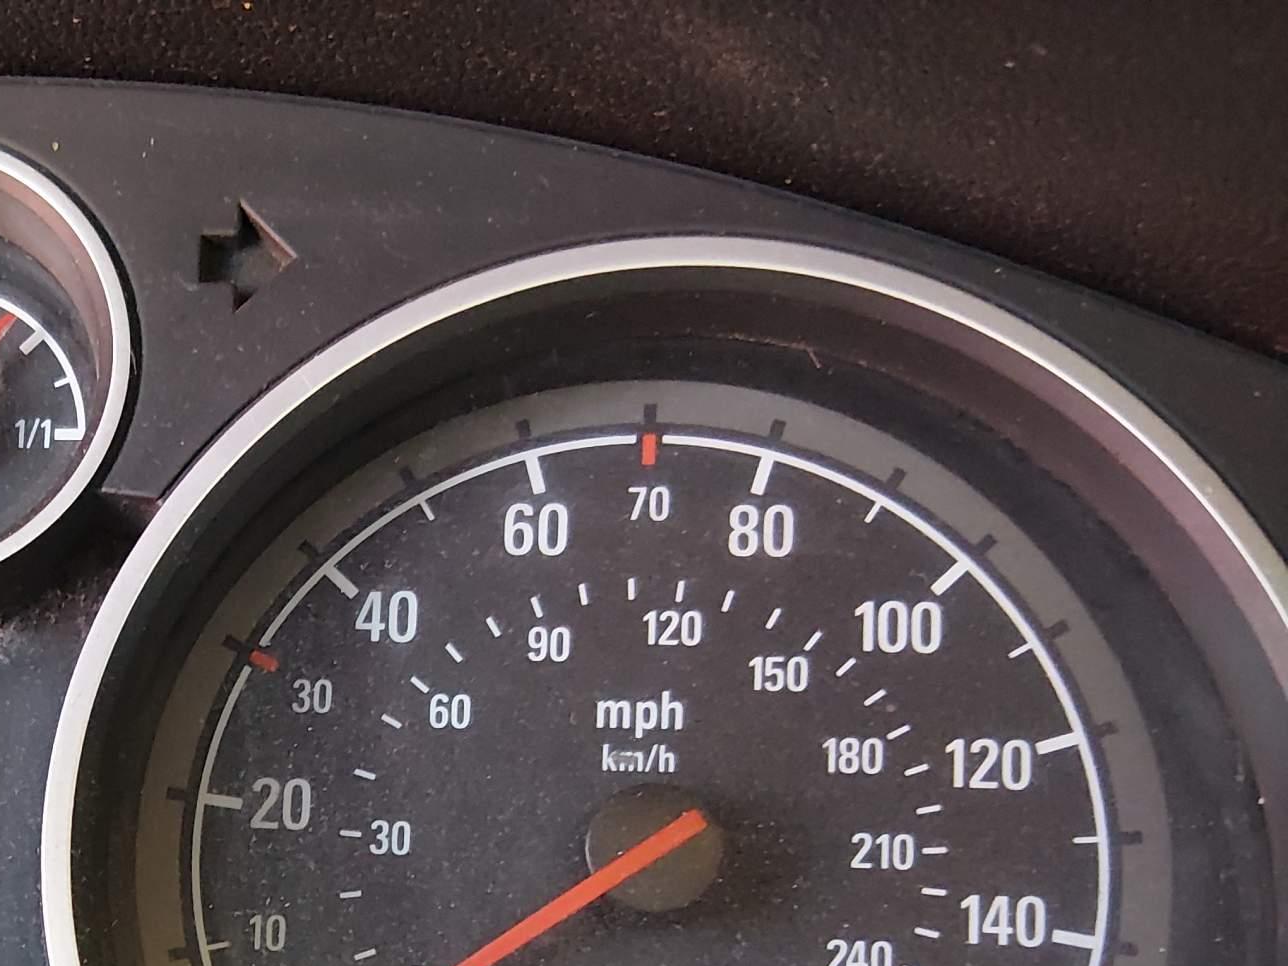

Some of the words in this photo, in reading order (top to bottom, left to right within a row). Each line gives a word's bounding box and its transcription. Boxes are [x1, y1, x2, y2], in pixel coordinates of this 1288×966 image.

[15, 418, 52, 449] 1/1
[627, 486, 670, 522] 70
[503, 503, 569, 556] 60
[728, 504, 794, 558] 80
[355, 590, 418, 643] 40
[643, 610, 702, 646] 120
[853, 600, 942, 654] 100
[528, 626, 570, 662] 90
[748, 656, 809, 692] 150
[291, 678, 333, 714] 30
[429, 693, 471, 730] 60
[596, 691, 684, 738] mph
[821, 737, 884, 775] 180
[944, 739, 1032, 791] 120
[250, 777, 312, 831] 20
[369, 820, 411, 855] 30
[850, 833, 914, 870] 210
[249, 914, 286, 951] 10
[960, 895, 1046, 948] 140
